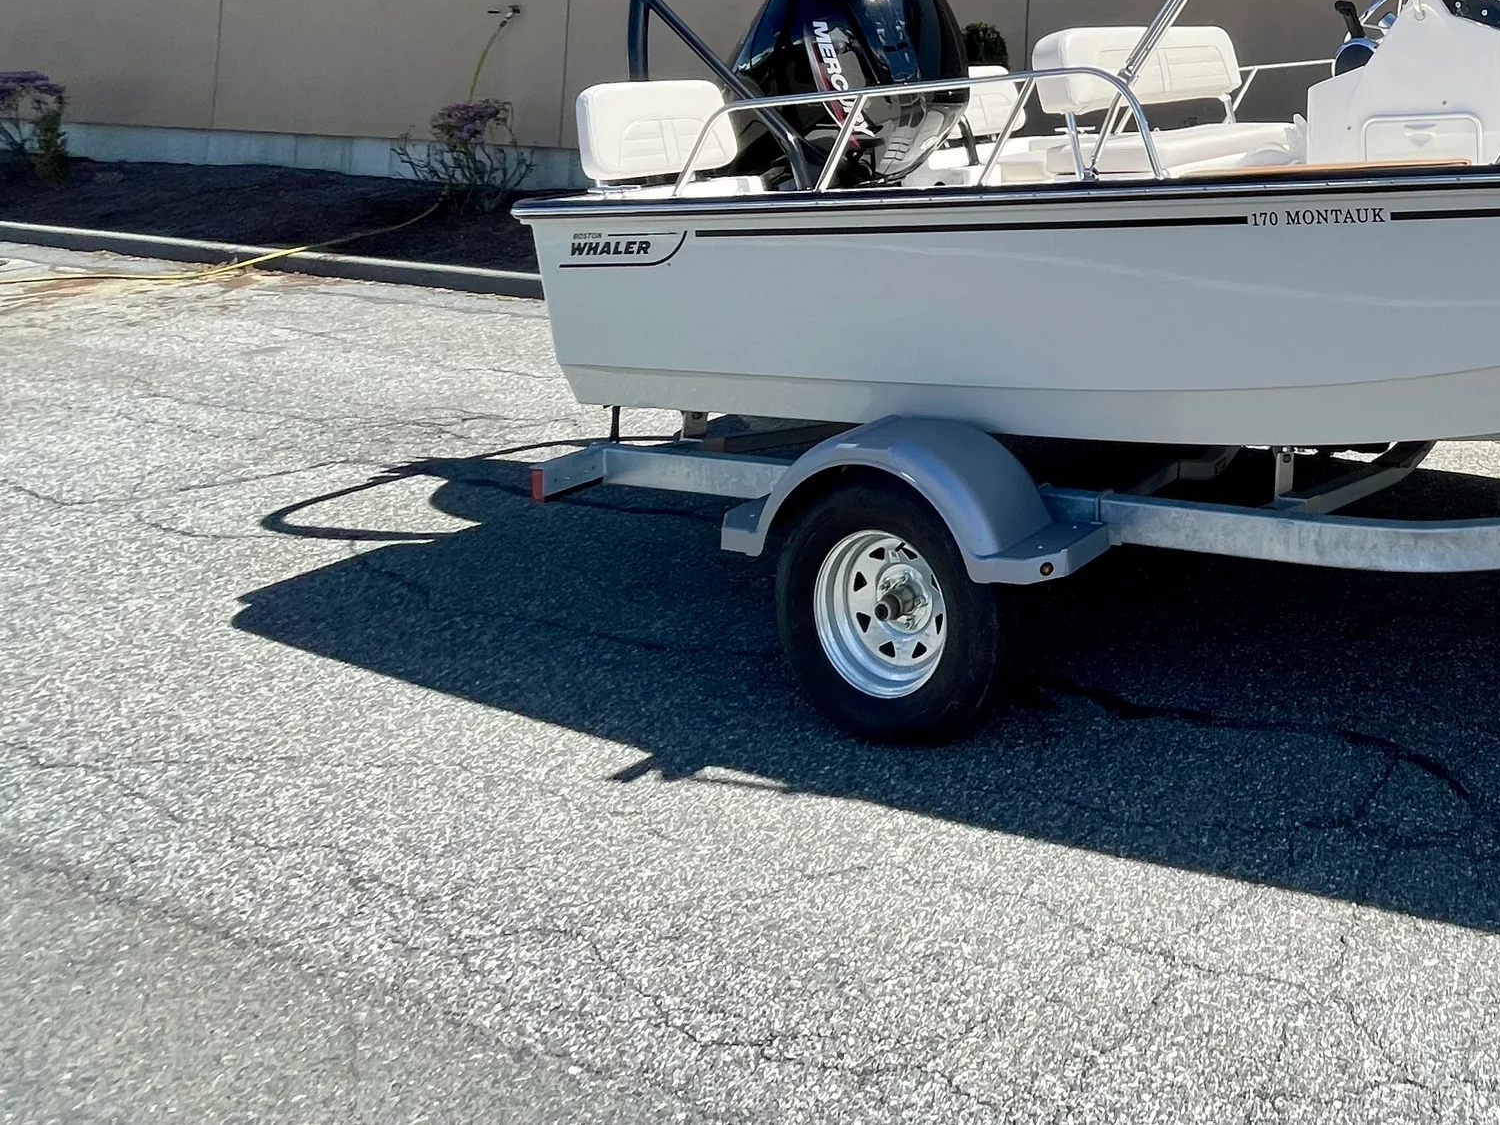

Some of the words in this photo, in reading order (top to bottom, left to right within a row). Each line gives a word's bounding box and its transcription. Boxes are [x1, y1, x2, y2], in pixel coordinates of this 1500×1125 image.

[1251, 211, 1278, 226] 170
[1285, 207, 1386, 225] MONTAUK
[572, 232, 603, 240] BOSTON
[570, 241, 651, 257] WHALER
